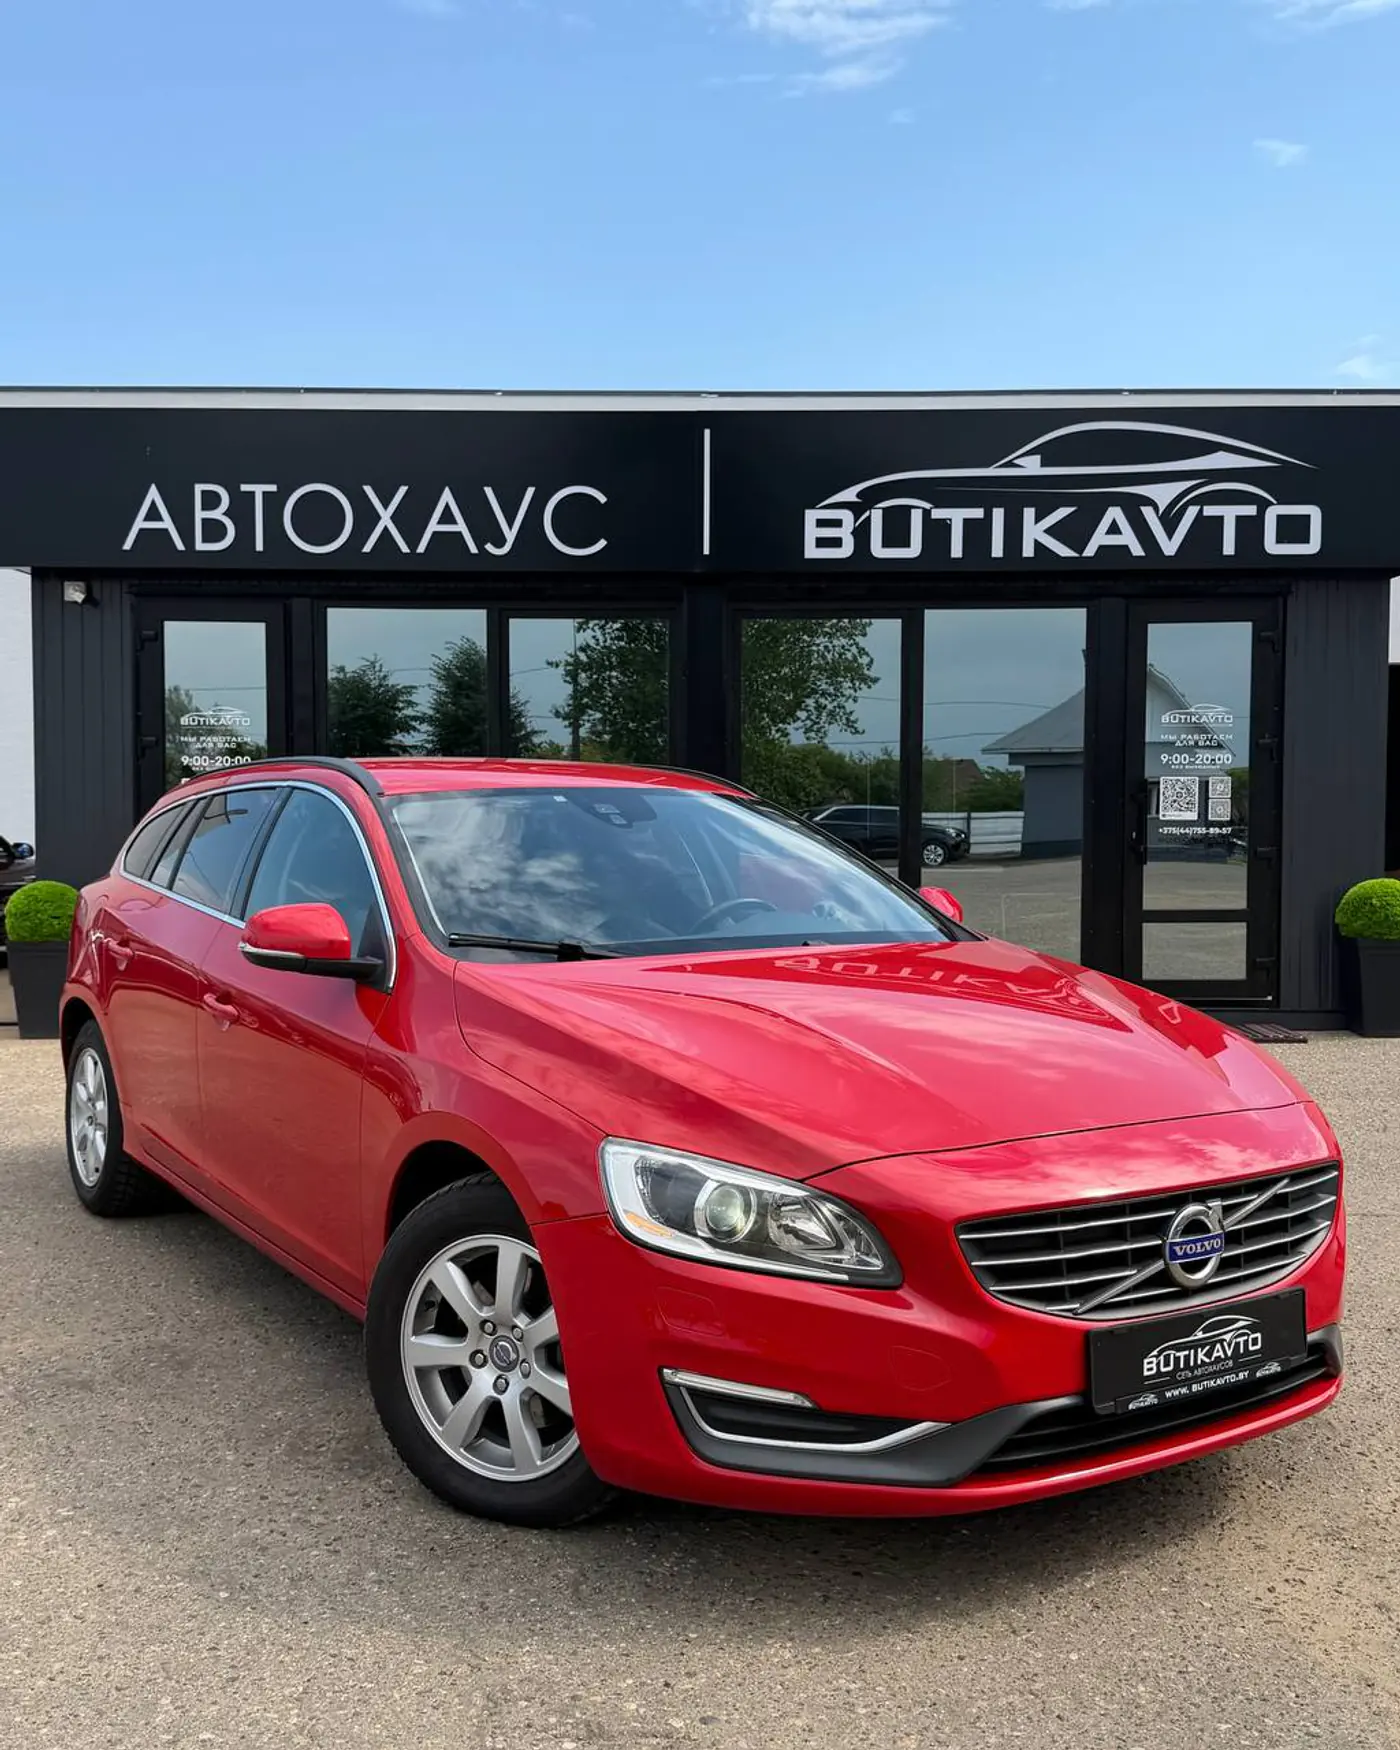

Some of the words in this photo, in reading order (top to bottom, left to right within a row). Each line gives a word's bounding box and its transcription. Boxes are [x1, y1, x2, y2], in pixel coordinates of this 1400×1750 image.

[121, 482, 609, 557] АВТОХАУС
[803, 504, 1323, 560] BUTIKAVTO
[1161, 714, 1233, 724] BUTIKAVTO
[180, 755, 252, 766] 9:00-20:00
[1160, 753, 1232, 765] 9:00-20:00
[1173, 1238, 1221, 1256] VOLVO
[1142, 1332, 1262, 1377] BUTIKAVTO
